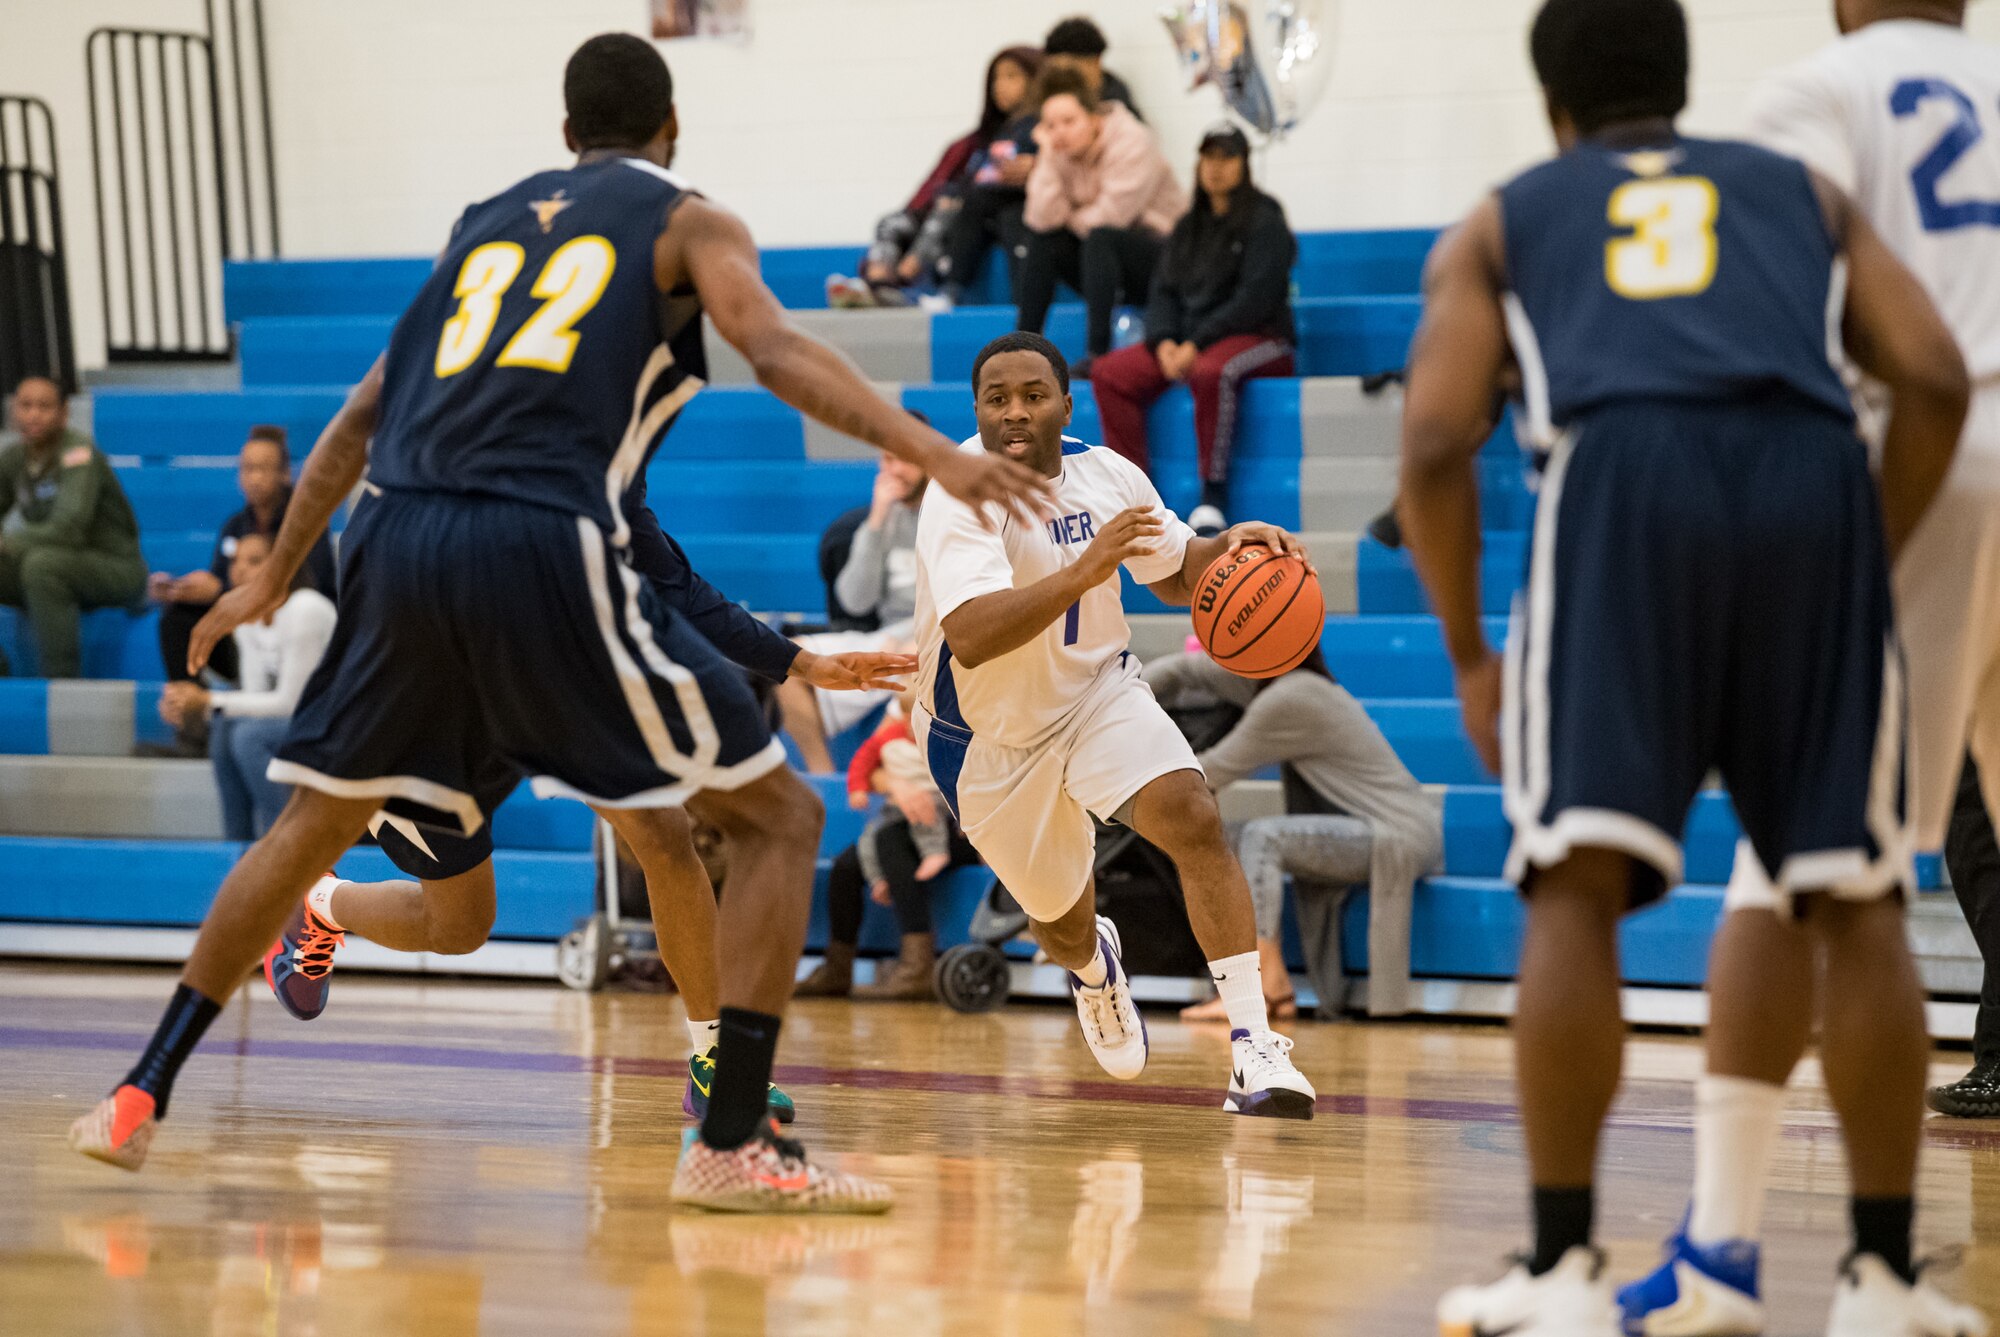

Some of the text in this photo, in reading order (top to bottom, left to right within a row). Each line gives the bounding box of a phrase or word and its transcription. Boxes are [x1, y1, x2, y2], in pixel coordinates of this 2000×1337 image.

[1890, 78, 2000, 232] 2
[1605, 175, 1720, 300] 3
[434, 234, 617, 379] 32
[1199, 549, 1266, 613] Wilson
[1228, 568, 1286, 637] EVOLUTION
